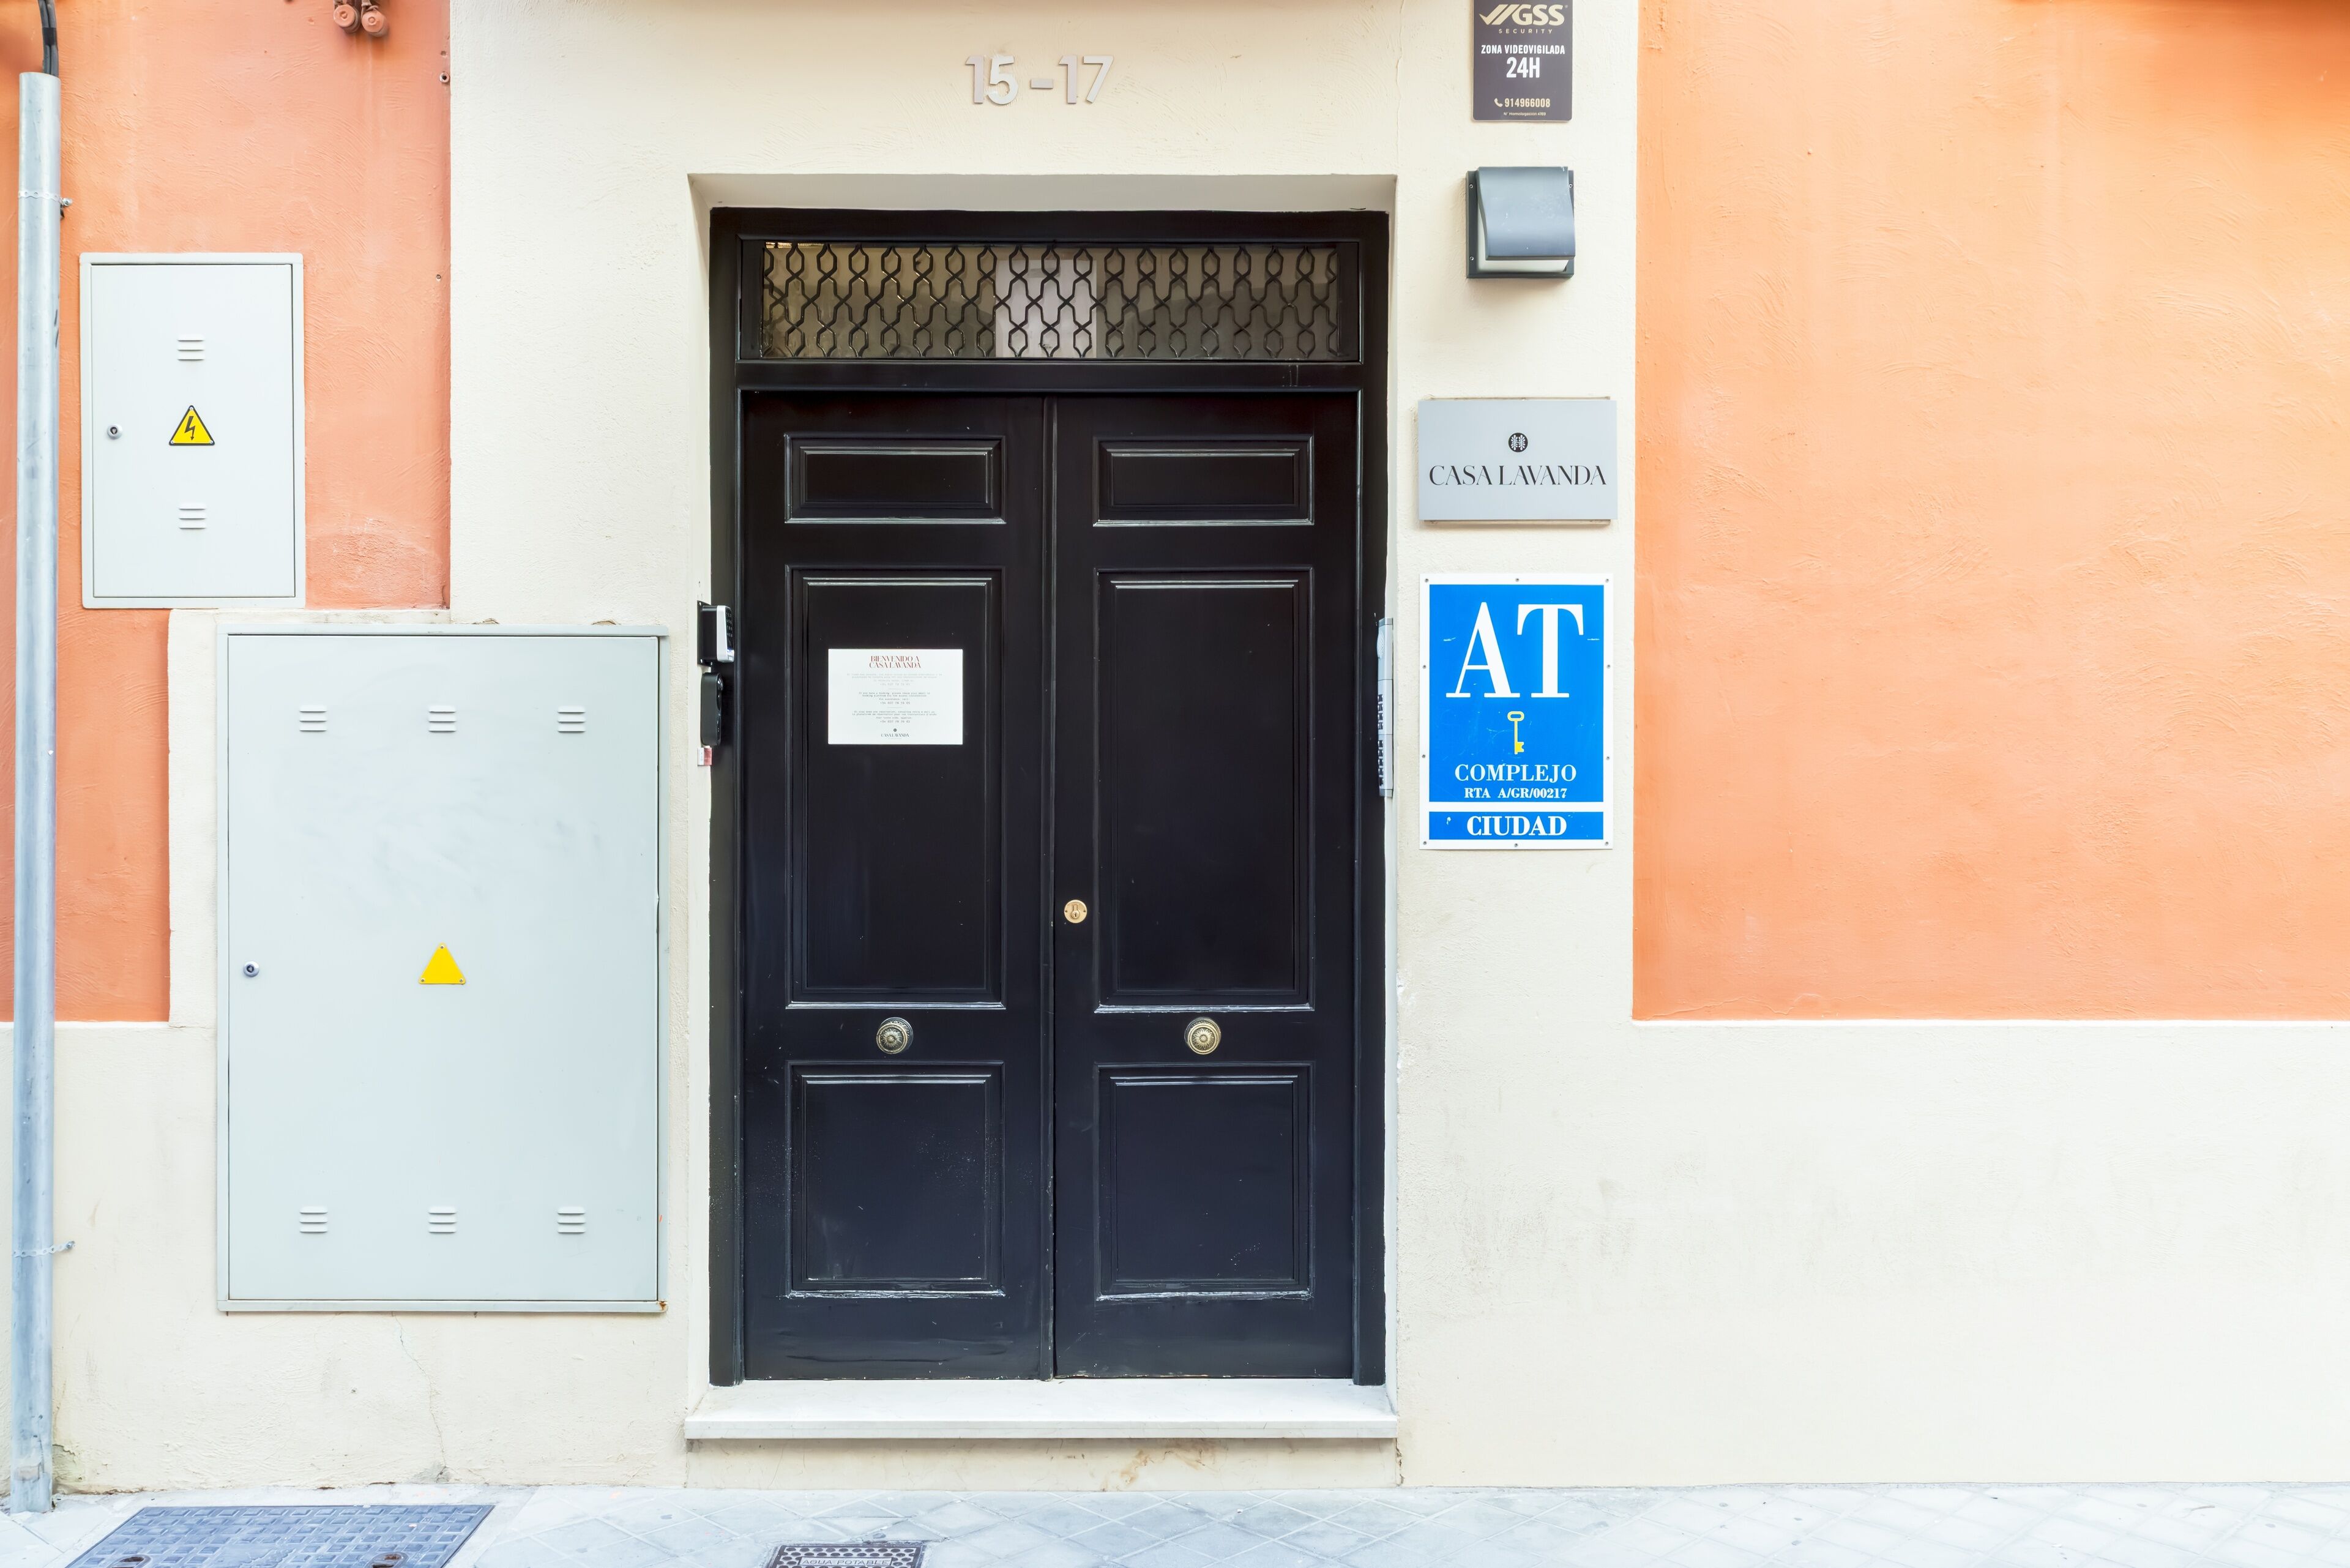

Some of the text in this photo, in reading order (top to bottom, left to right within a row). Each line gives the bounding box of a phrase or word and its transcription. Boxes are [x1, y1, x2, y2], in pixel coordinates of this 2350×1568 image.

[1512, 4, 1565, 26] GSS
[1481, 45, 1565, 54] ZONA VIDEOVIGILADA
[1506, 56, 1540, 78] 24H
[1504, 98, 1551, 108] 914966008
[1429, 465, 1606, 485] CASA LAVANDA
[1445, 602, 1584, 698] AT
[1455, 764, 1576, 783] COMPLEJO
[1464, 788, 1567, 799] RTA A/GR/00217
[1467, 815, 1567, 836] CIUDAD
